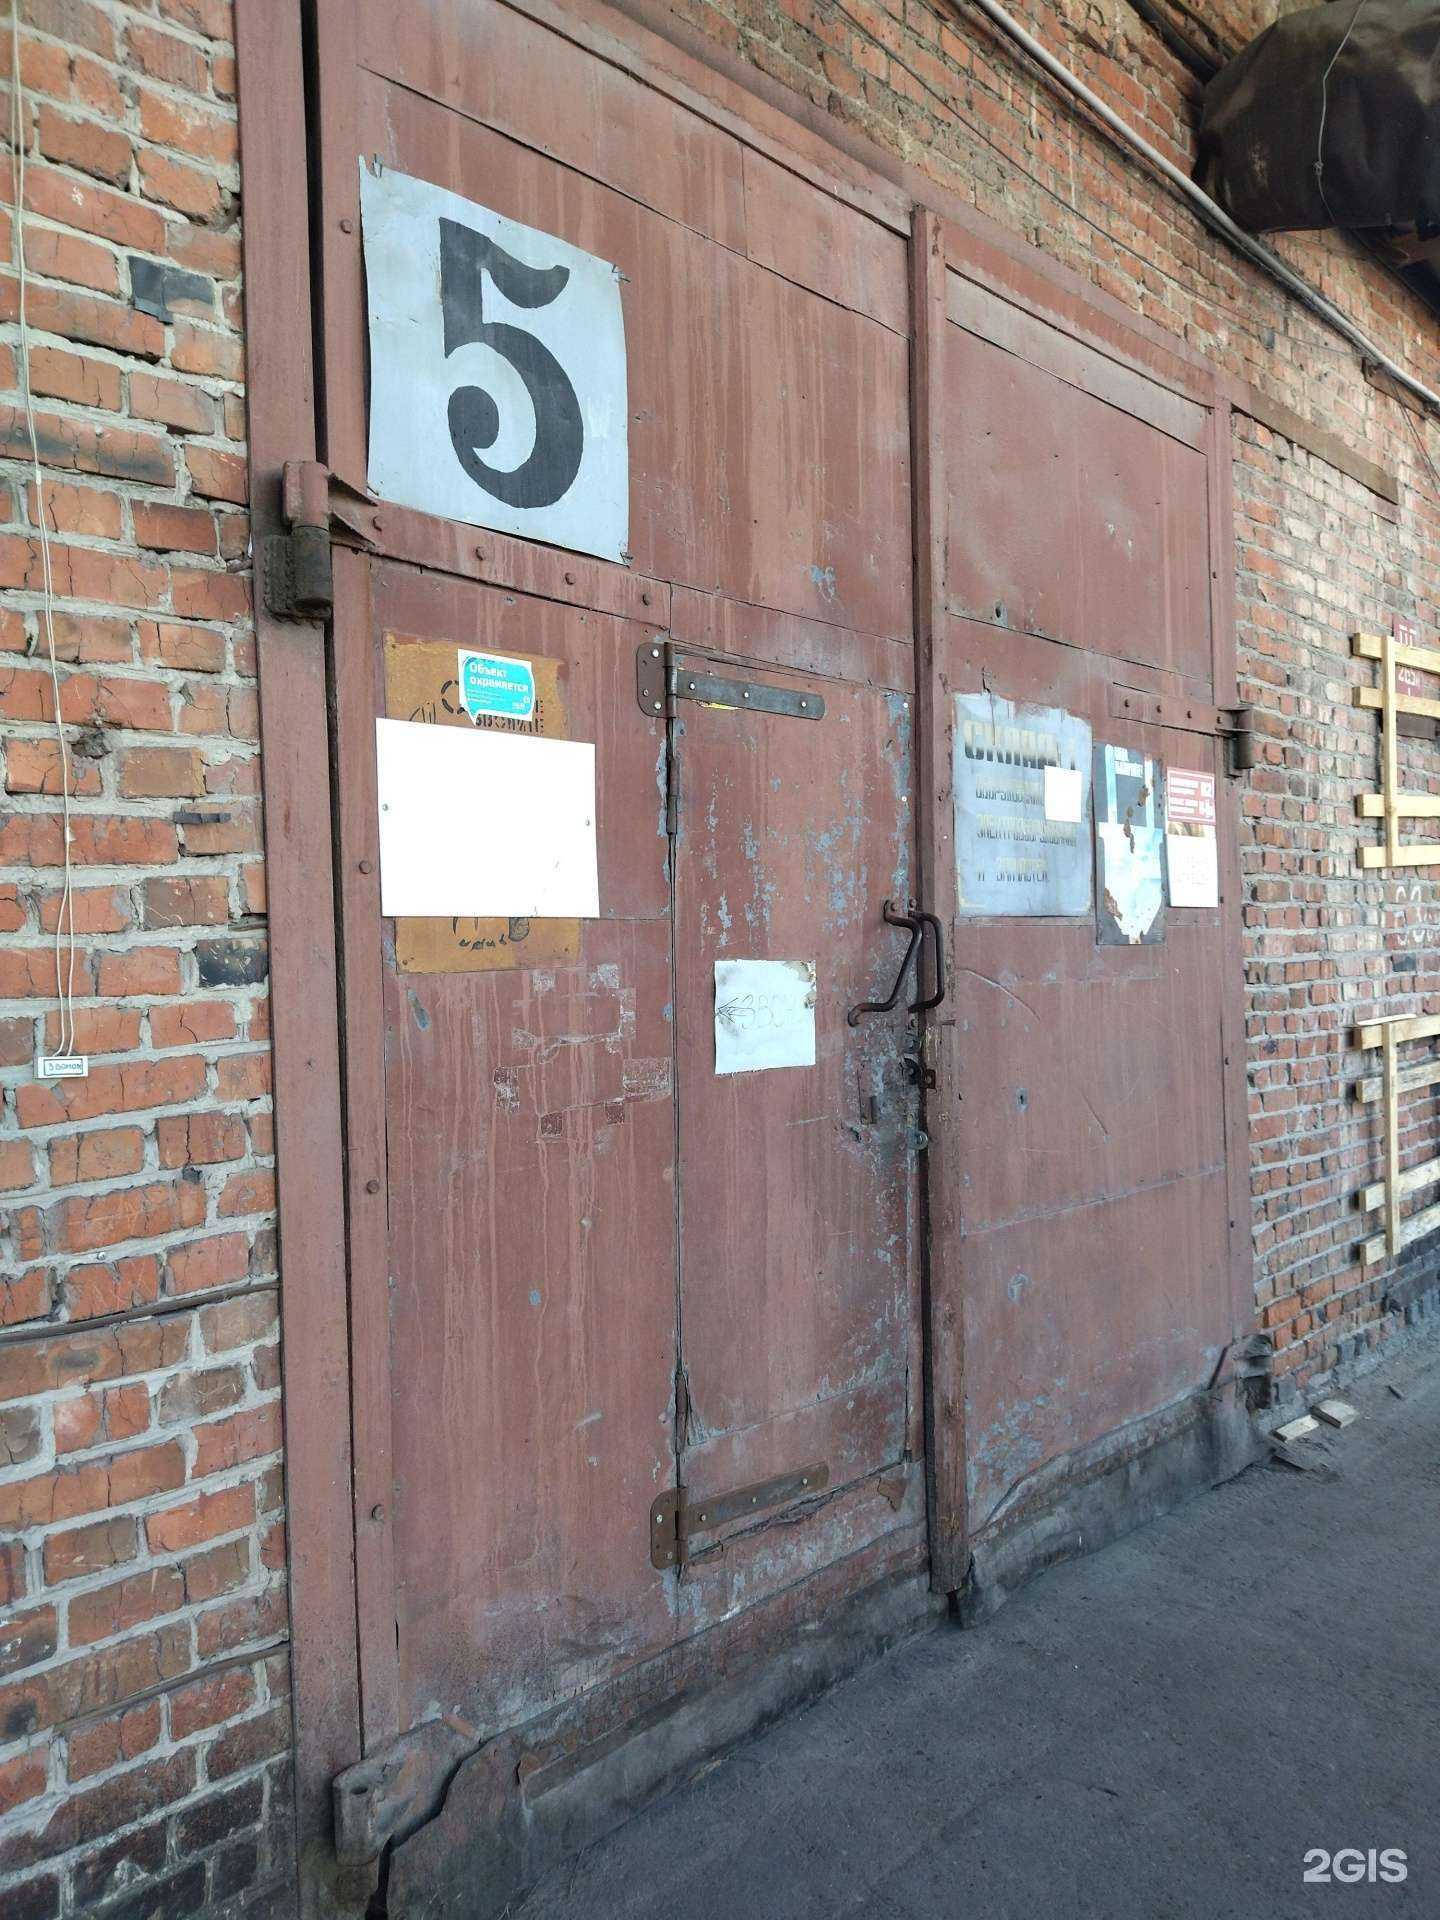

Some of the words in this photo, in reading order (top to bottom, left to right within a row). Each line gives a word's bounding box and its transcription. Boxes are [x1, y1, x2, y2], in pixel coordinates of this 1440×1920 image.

[438, 216, 584, 509] 5
[469, 663, 507, 679] Объект
[469, 676, 529, 693] охраняется
